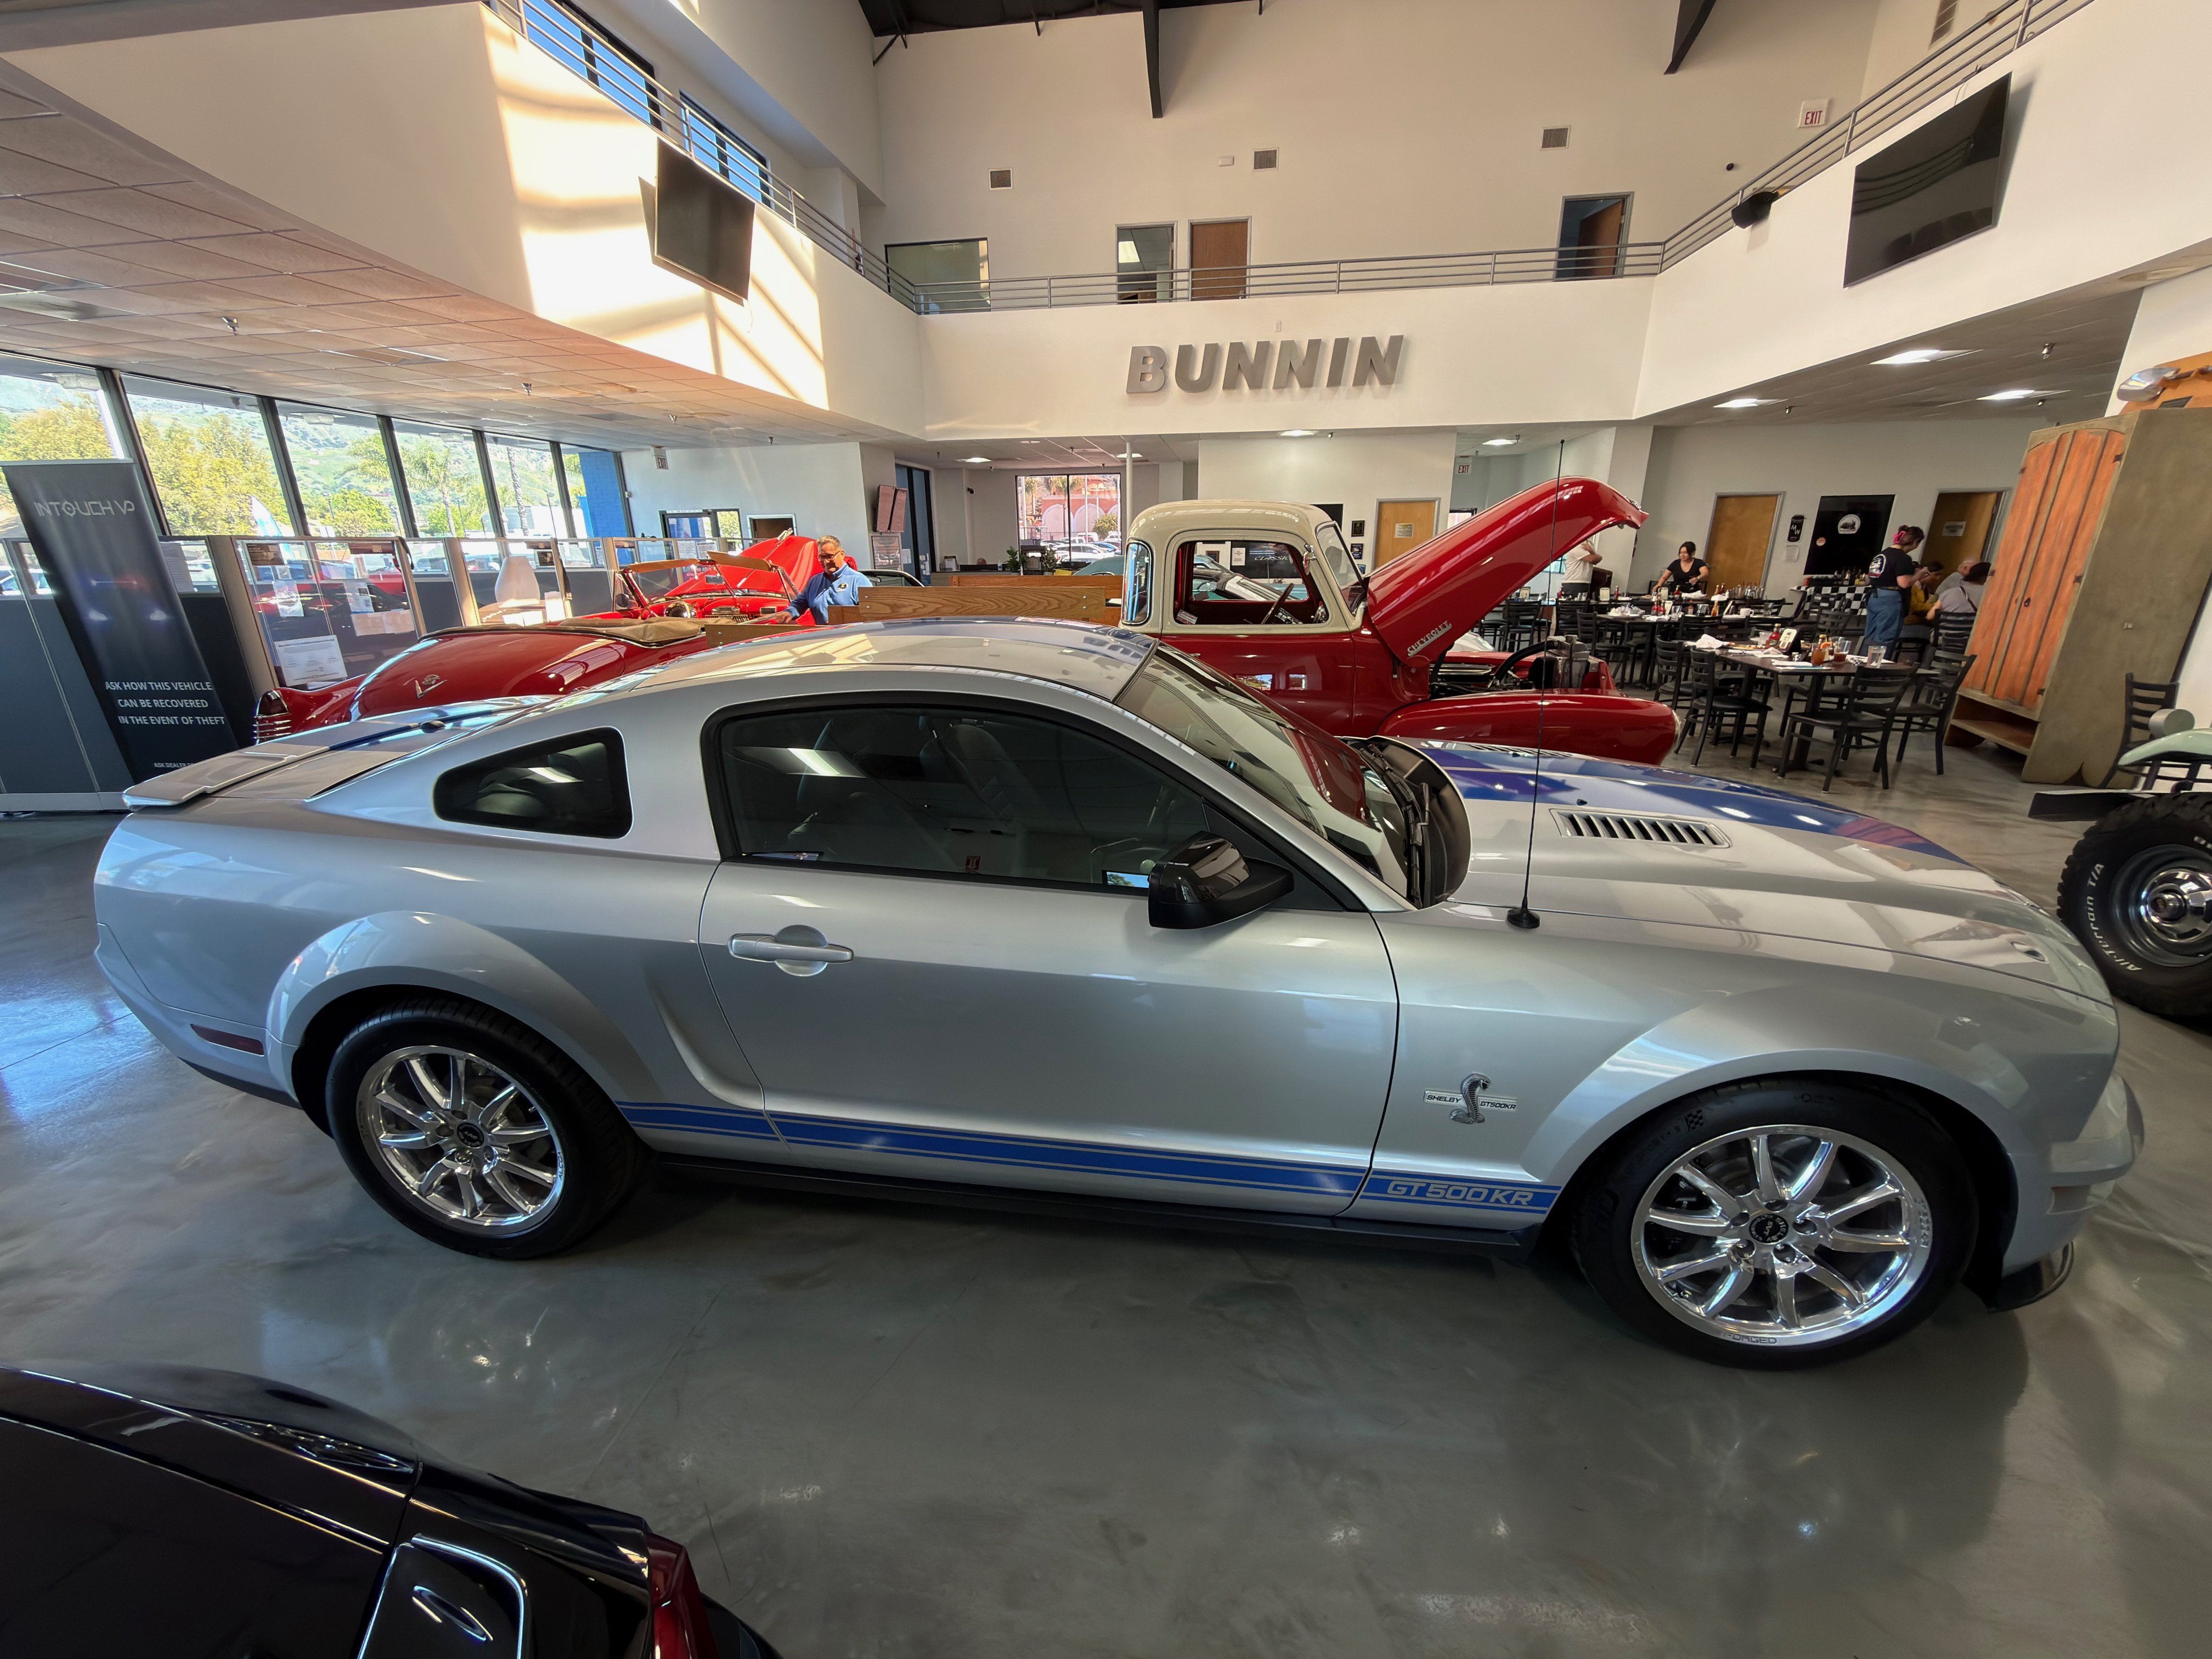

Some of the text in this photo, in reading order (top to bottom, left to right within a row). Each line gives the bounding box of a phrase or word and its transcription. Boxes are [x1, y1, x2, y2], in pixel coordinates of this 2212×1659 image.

[1804, 110, 1822, 125] EXIT
[1126, 335, 1404, 394] BUNNIN
[1458, 465, 1470, 473] EXIT
[1407, 620, 1452, 657] CHEVROLET
[105, 681, 213, 691] ASK HOW THIS VEHICLE
[118, 699, 208, 708] CAN BE RECOVERED
[118, 716, 225, 725] IN THE EVENT OF THEFT
[2087, 864, 2105, 887] T/A
[1427, 1094, 1462, 1103] SHELBY
[1480, 1101, 1516, 1109] GT500KR
[1725, 1331, 1777, 1344] FORGED
